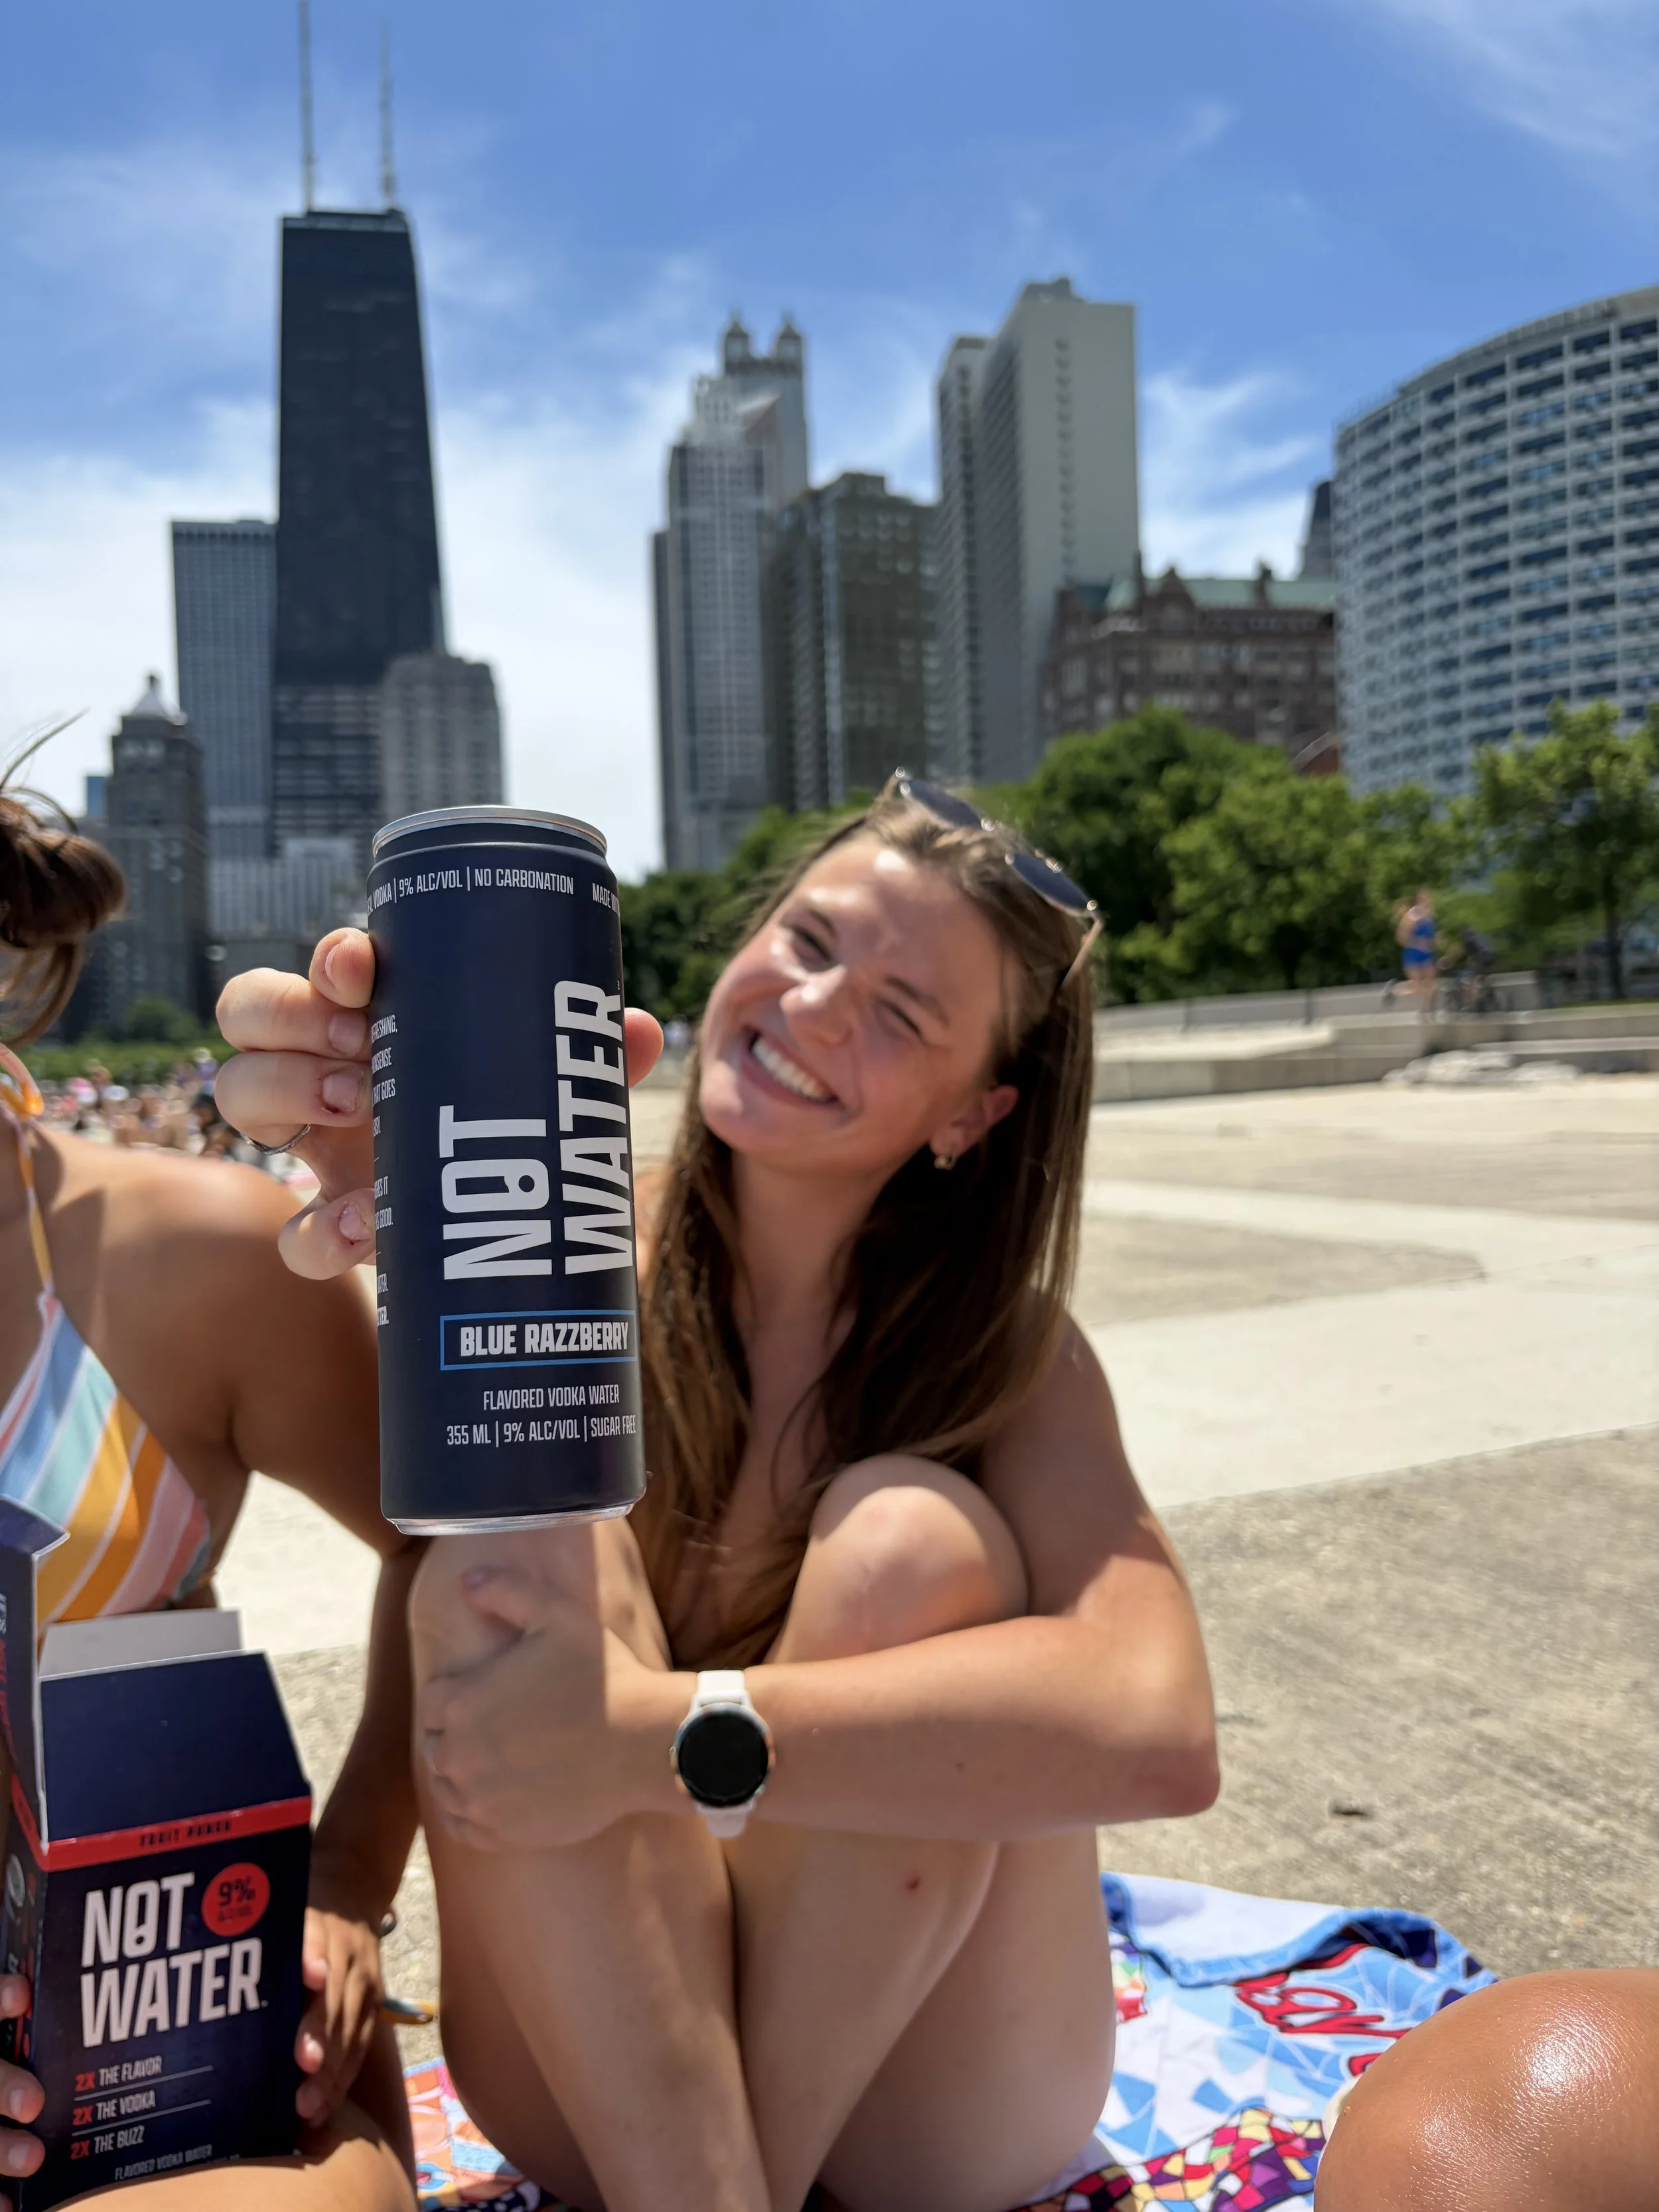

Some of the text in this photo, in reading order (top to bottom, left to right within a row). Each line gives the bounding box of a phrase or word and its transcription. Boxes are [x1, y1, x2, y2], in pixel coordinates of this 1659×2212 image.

[373, 883, 392, 909] VODKA
[399, 877, 413, 897] 9%
[417, 869, 463, 893] ALC/VOL
[474, 869, 492, 887] NO
[496, 869, 574, 895] CARBONATION
[592, 883, 611, 909] MADE
[381, 1078, 396, 1102] GOES
[554, 980, 633, 1275] WATER
[384, 1176, 389, 1195] IT
[439, 1104, 552, 1280] NOT
[461, 1321, 628, 1357] BLUE RAZZBERRY
[483, 1384, 620, 1410] FLAVORED VODKA WATER
[447, 1414, 636, 1445] 355 ML 9% ALC/VOL SUGAR FREE
[217, 1876, 257, 1907] 9%
[81, 1872, 195, 1968] NOT
[80, 1937, 263, 2048] WATER
[74, 2055, 162, 2092] 2X THE FLAVOR
[72, 2090, 156, 2126] 2X THE VODKA
[70, 2125, 145, 2160] 2X THE BUZZ
